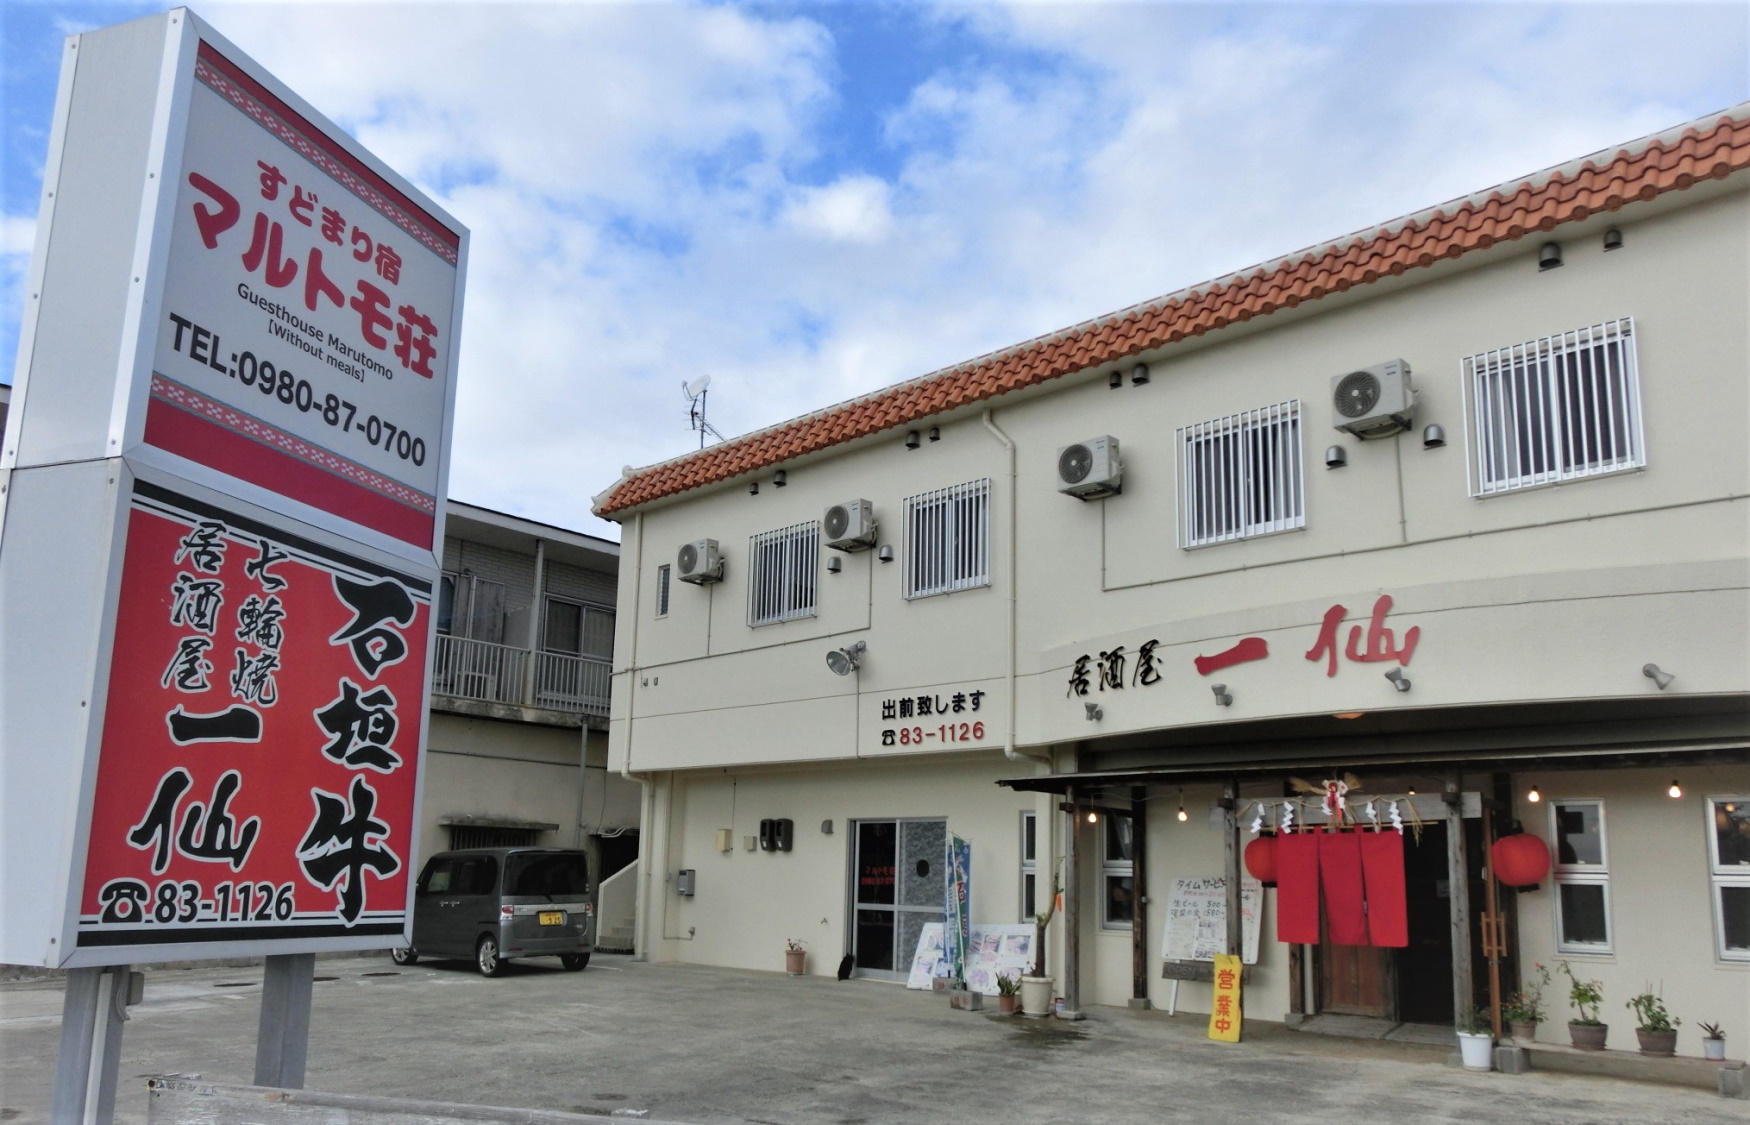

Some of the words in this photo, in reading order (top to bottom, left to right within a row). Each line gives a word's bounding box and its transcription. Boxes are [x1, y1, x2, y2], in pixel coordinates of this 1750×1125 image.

[188, 172, 438, 380] マルトモ荘
[257, 160, 403, 286] すどまり宿
[237, 283, 324, 342] Guesthouse
[328, 333, 393, 380] Marutomo
[169, 313, 427, 467] TEL:0980-87-0700
[162, 521, 226, 691] 居酒屋
[232, 540, 288, 704] 七輪焼
[1066, 639, 1163, 699] 居酒屋
[1194, 594, 1420, 677] 一仙
[298, 574, 414, 926] 石垣牛
[881, 690, 986, 721] 出前致します
[899, 721, 985, 746] 83-1126
[154, 883, 293, 923] 83-1126
[1214, 968, 1236, 1034] 営業中
